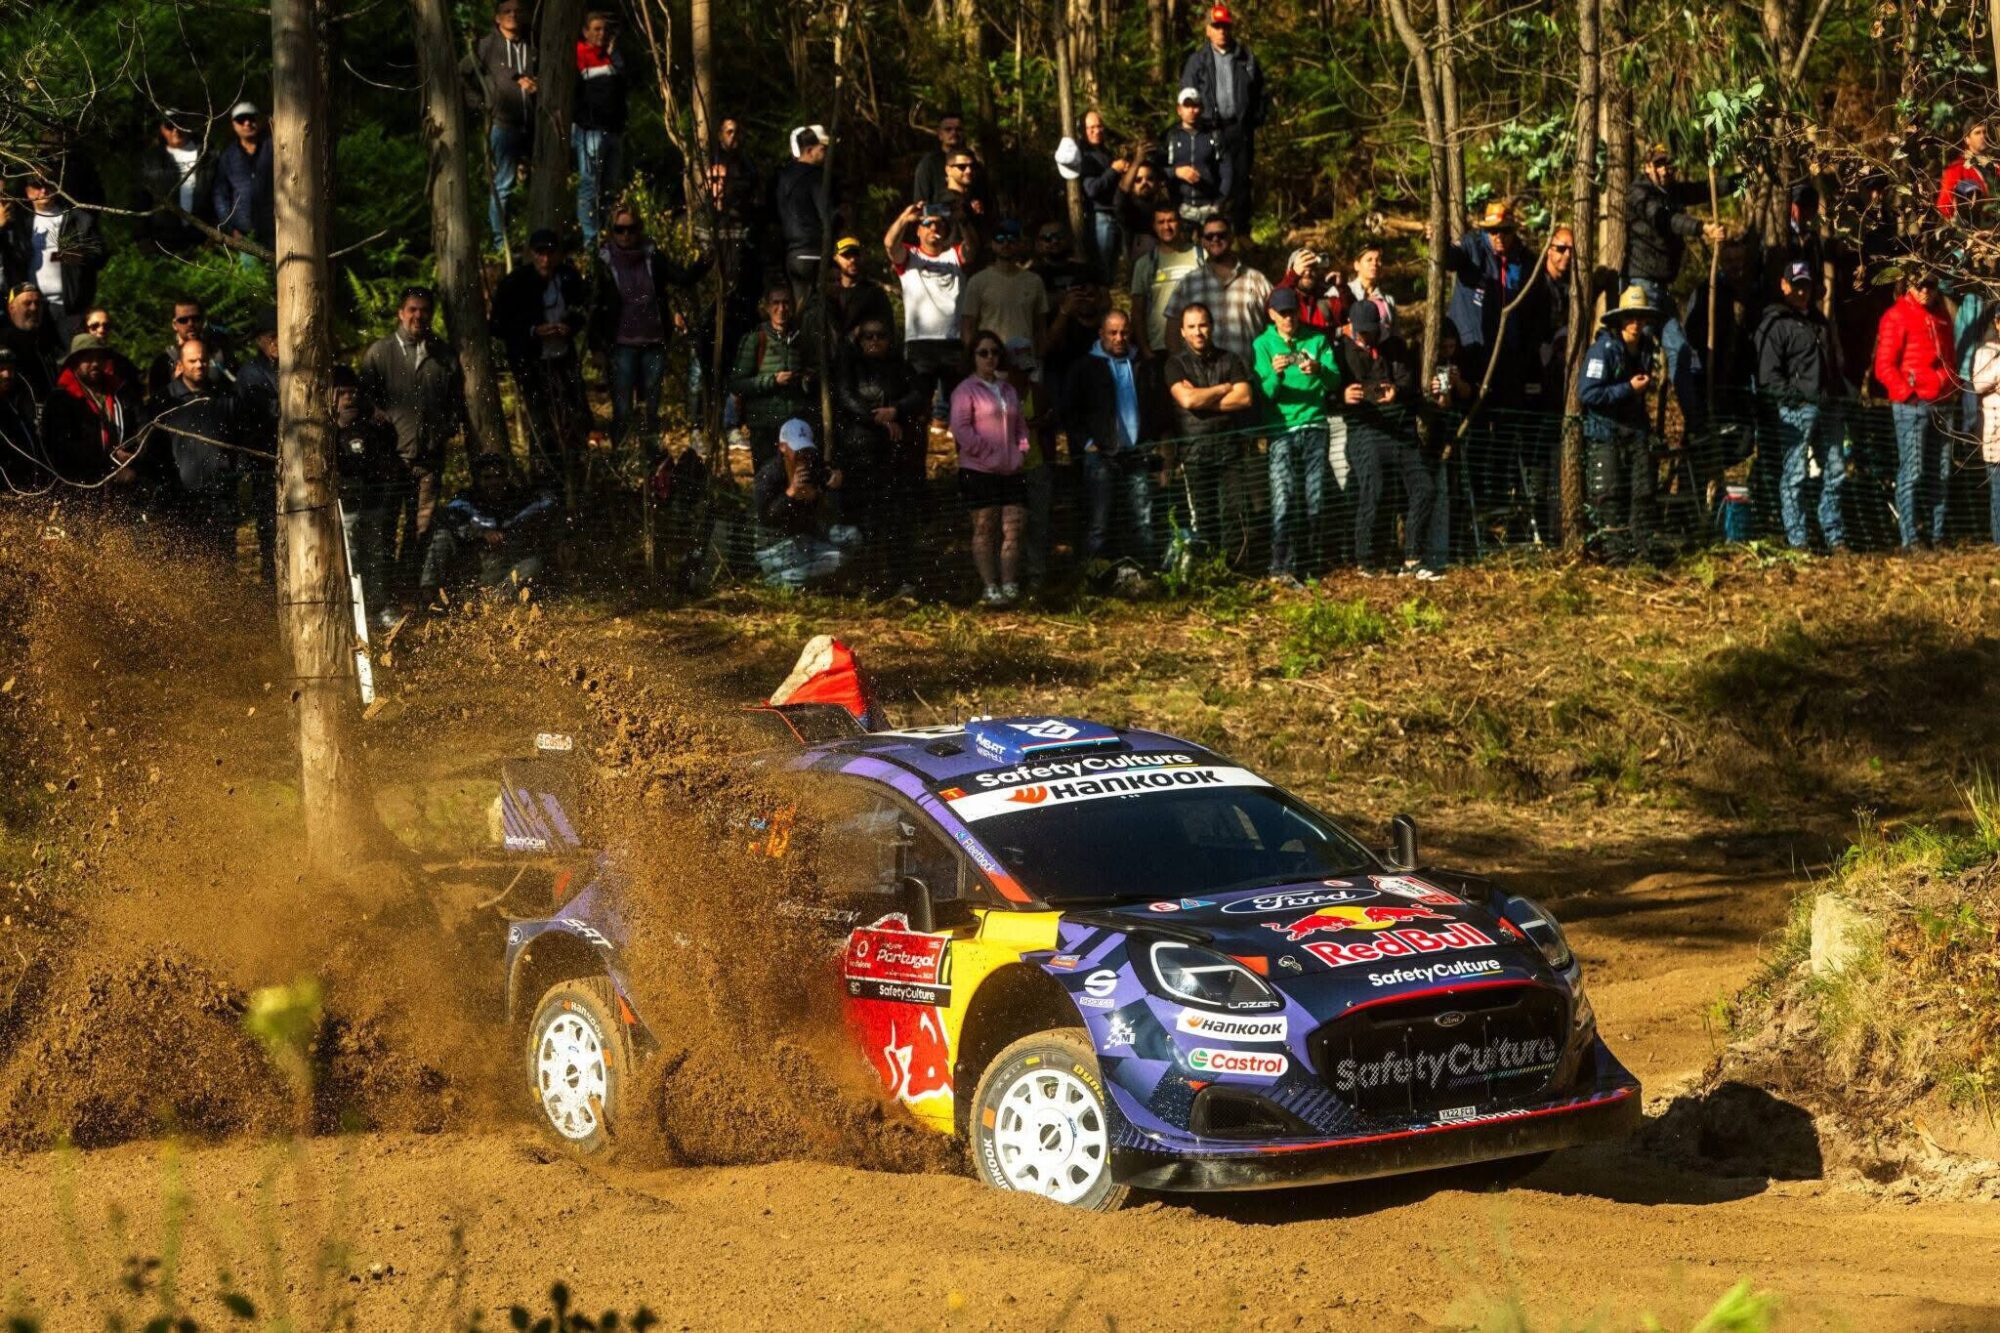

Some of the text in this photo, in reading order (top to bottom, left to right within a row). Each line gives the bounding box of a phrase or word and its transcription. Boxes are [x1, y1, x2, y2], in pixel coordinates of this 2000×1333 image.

[975, 753, 1194, 787] SafetyCulture
[1252, 891, 1356, 910] Ford
[1302, 923, 1497, 967] Red Bull
[876, 949, 936, 968] Portugal
[1368, 959, 1500, 986] SafetyCulture
[879, 985, 935, 1001] SafetyCulture
[1211, 1053, 1282, 1073] Castrol
[1336, 1036, 1556, 1090] SafetyCulture
